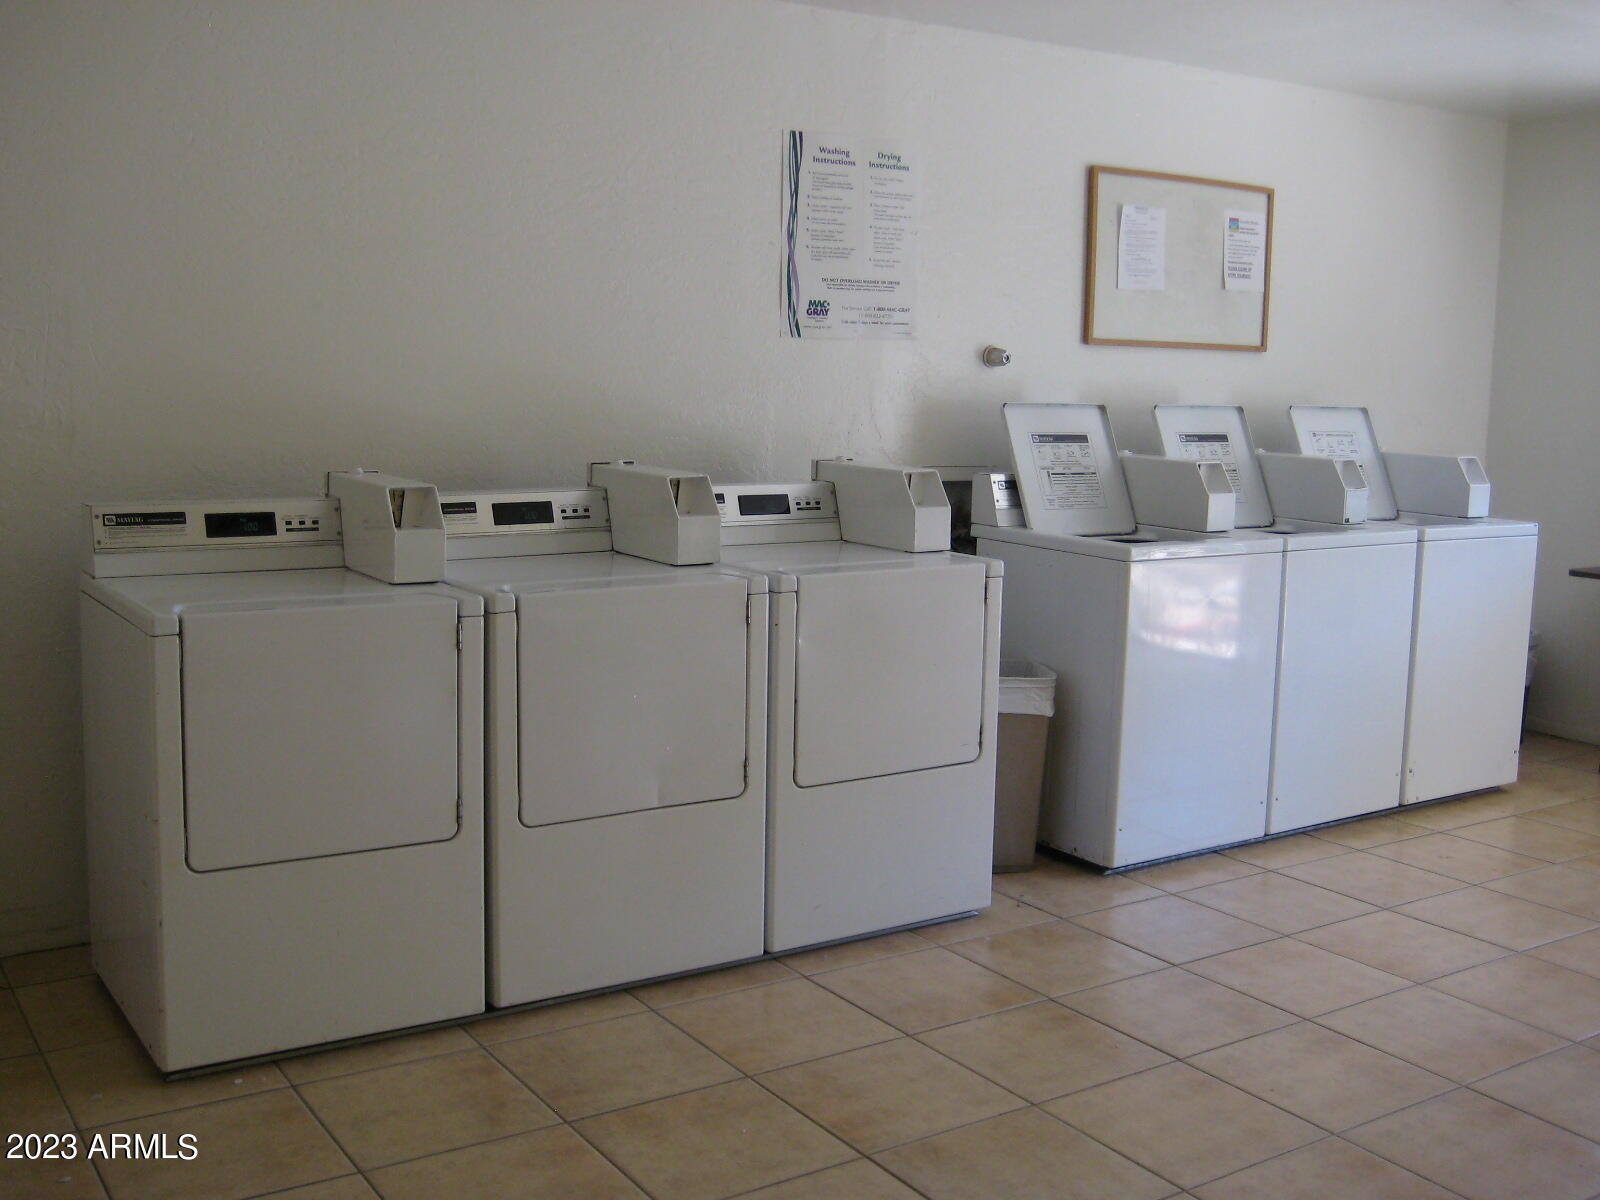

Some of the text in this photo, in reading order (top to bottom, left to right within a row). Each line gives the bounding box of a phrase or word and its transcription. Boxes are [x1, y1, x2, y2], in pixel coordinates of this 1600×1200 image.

[819, 146, 850, 158] Washing
[877, 152, 902, 162] Drying
[812, 155, 856, 167] Instructions
[868, 161, 910, 171] Instructions
[806, 308, 830, 316] GRAY
